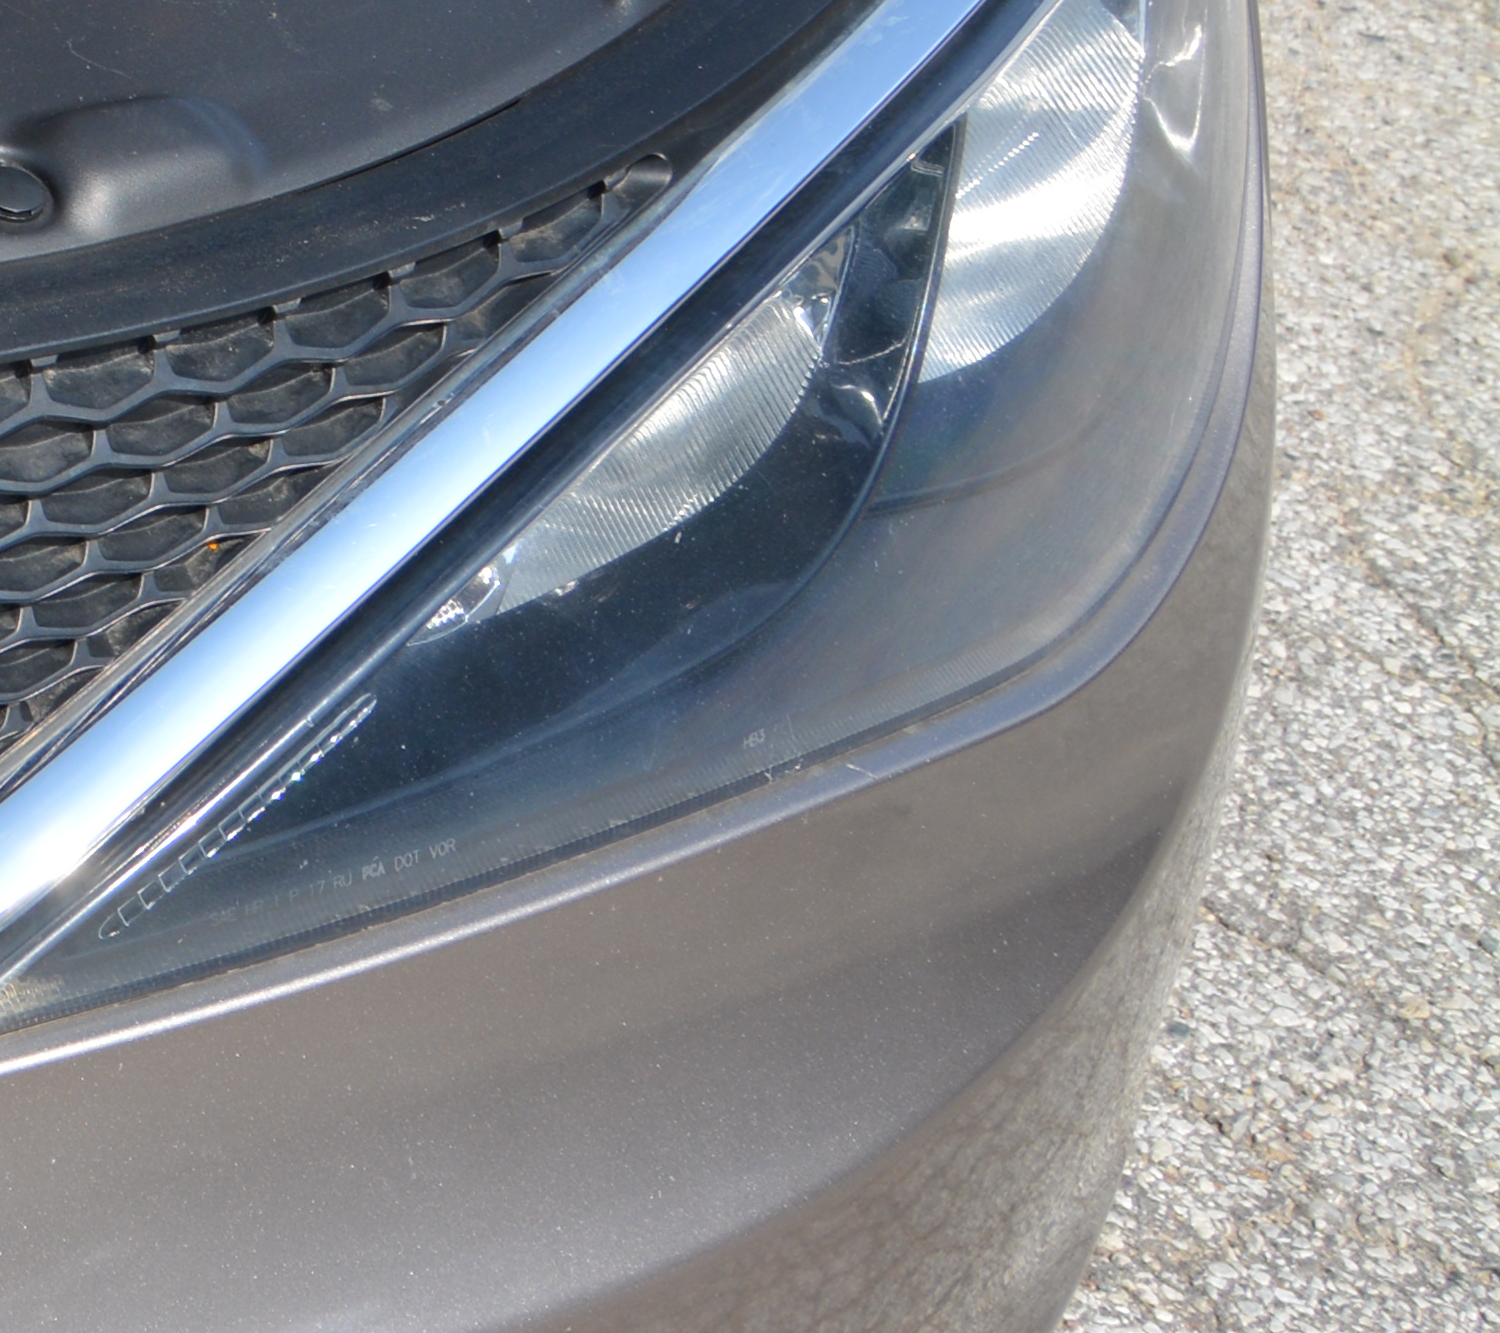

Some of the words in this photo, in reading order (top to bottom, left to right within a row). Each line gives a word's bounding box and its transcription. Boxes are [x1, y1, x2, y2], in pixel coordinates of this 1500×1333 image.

[209, 906, 237, 927] SAE
[394, 849, 420, 872] DOT
[429, 838, 457, 859] VOR
